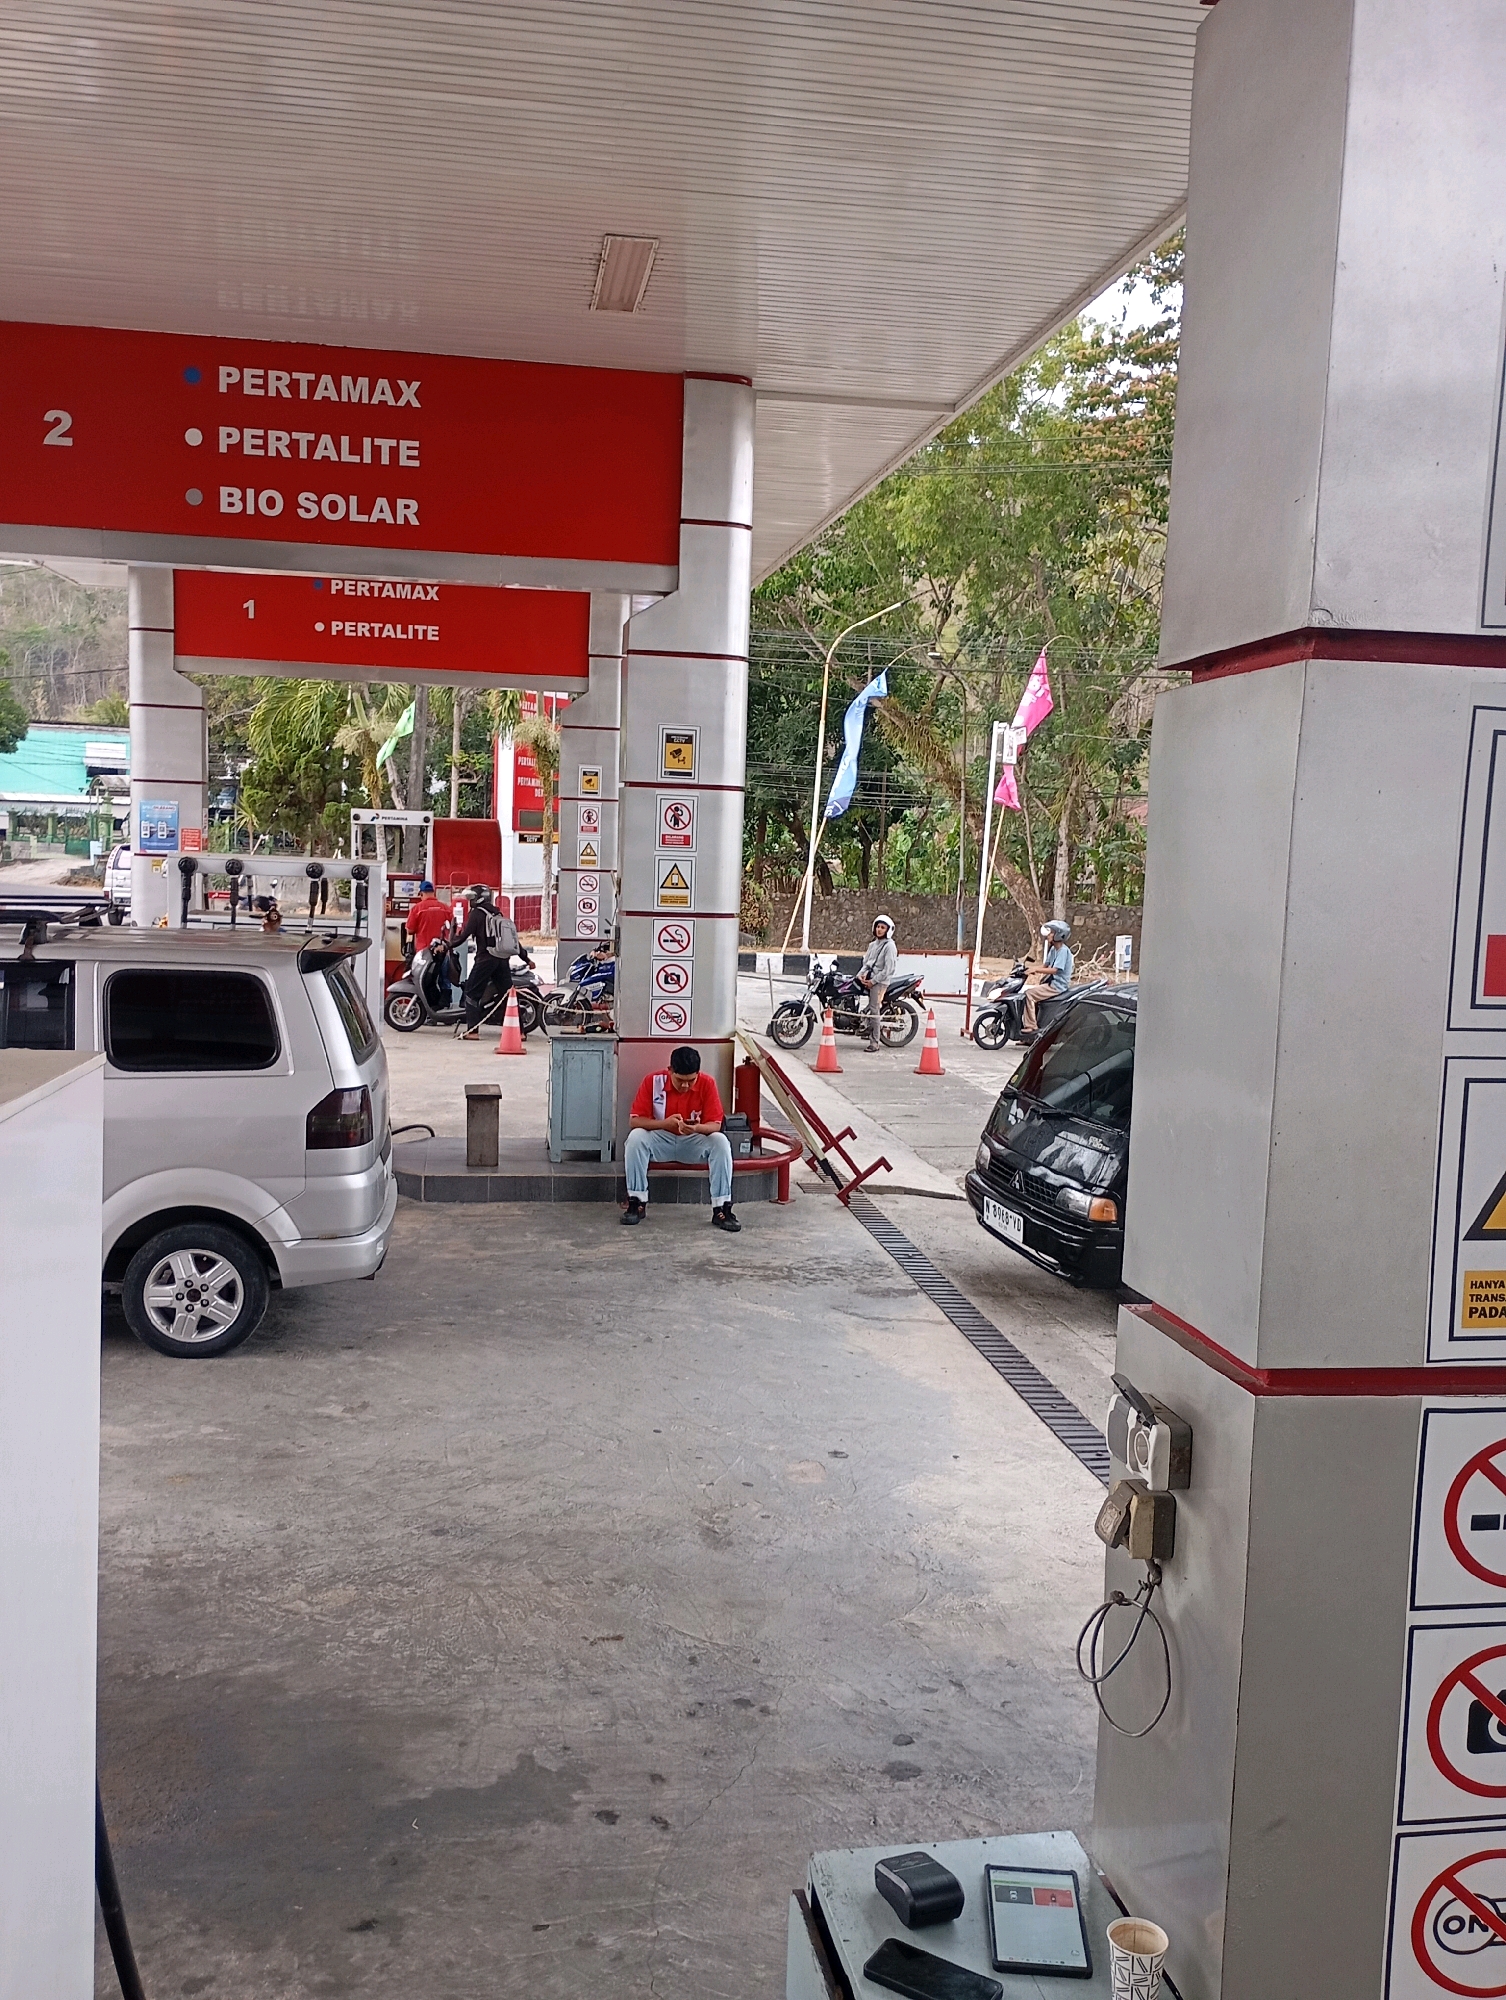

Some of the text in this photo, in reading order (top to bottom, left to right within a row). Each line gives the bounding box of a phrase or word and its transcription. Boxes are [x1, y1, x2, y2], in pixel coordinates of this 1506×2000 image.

[218, 365, 422, 408] PERTAMAX
[43, 409, 73, 447] 2
[218, 425, 420, 467] PERTALITE
[219, 486, 420, 526] BIO SOLAR
[330, 579, 440, 601] PERTAMAX
[242, 599, 255, 619] 1
[331, 620, 440, 641] PERTALITE
[517, 777, 542, 787] PERTAMIN
[1470, 1280, 1505, 1289] HANYA
[1469, 1293, 1506, 1302] TRANS
[1468, 1306, 1506, 1319] PADA
[1442, 1914, 1489, 1935] ON
